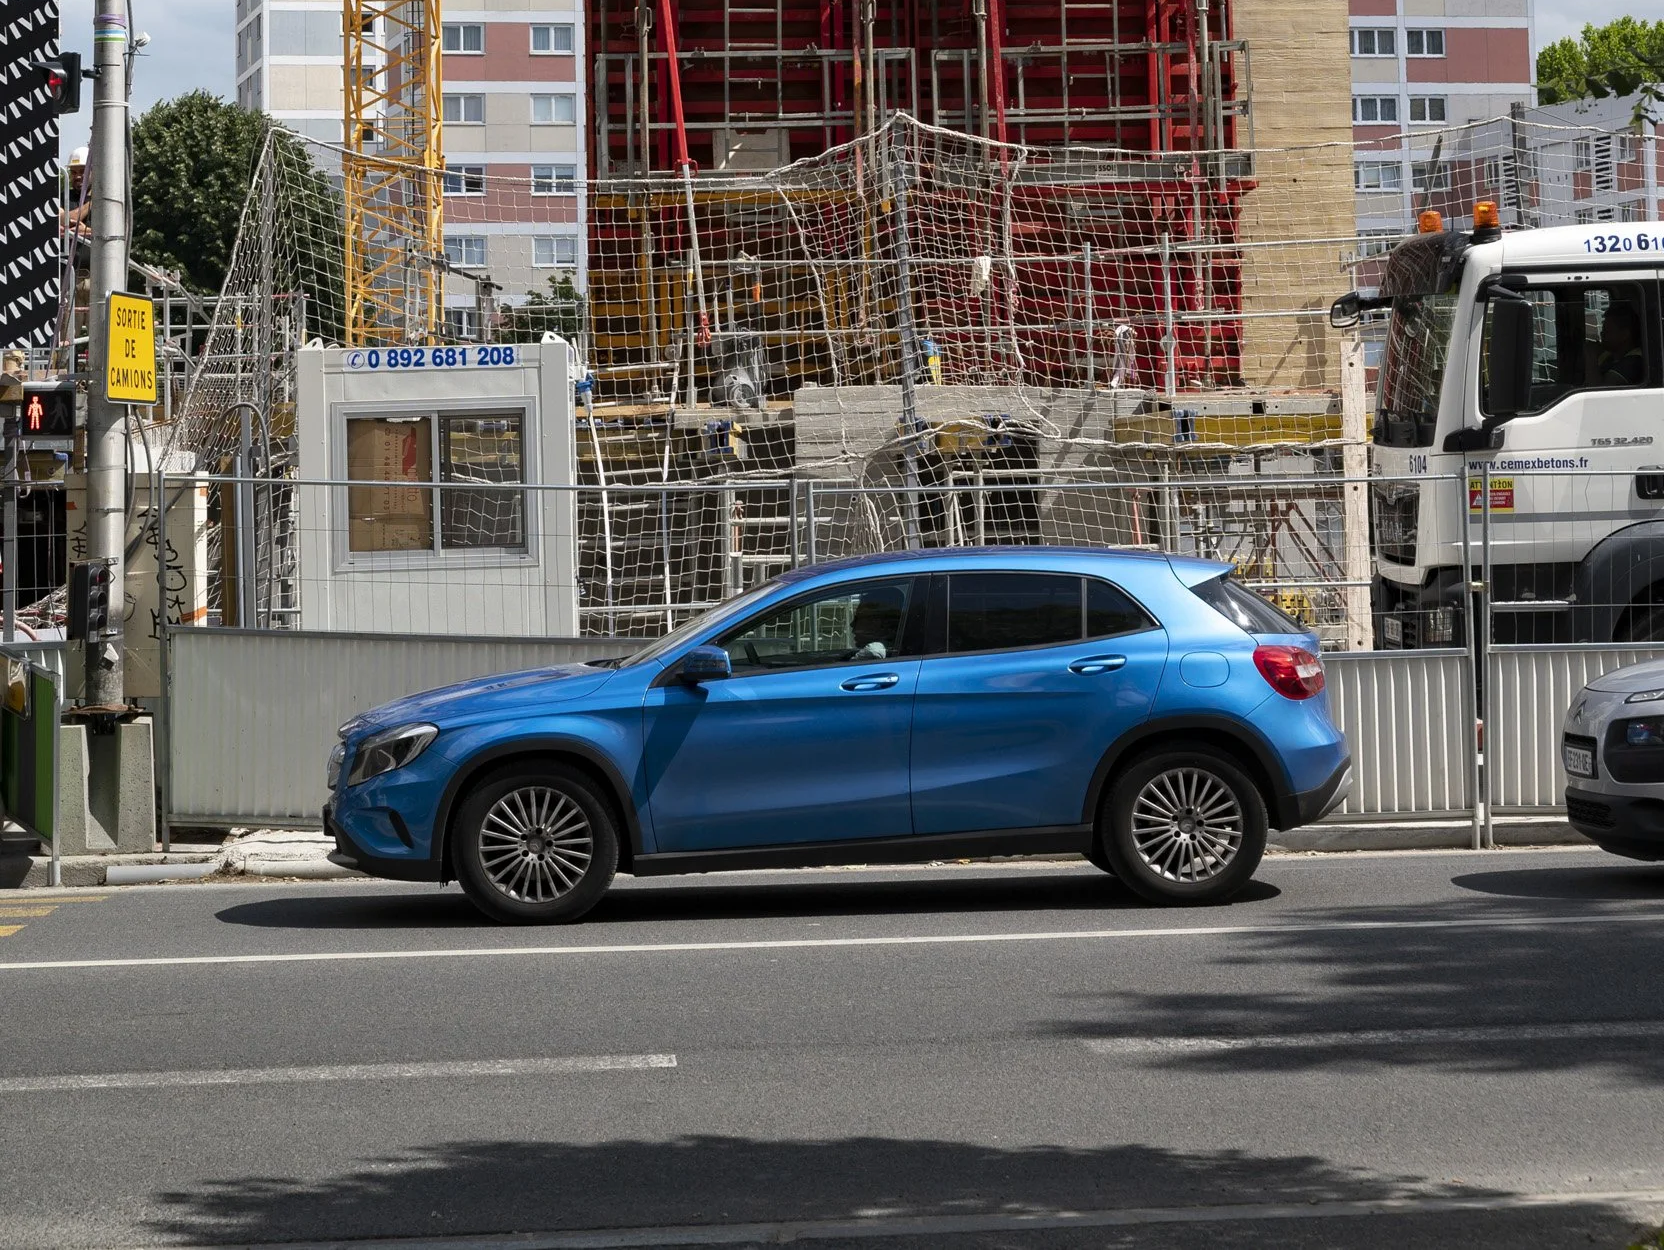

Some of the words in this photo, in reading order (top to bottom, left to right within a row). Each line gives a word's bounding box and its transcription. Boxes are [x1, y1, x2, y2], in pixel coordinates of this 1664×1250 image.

[1636, 232, 1664, 251] 61
[116, 307, 146, 330] SORTIE
[125, 338, 136, 359] DE
[368, 350, 380, 369] 0
[387, 349, 426, 368] 892
[431, 348, 467, 367] 681
[477, 346, 515, 366] 208
[110, 366, 153, 390] CAMIONS
[1613, 436, 1654, 446] 32.420
[1409, 454, 1427, 474] 6104
[1470, 480, 1513, 489] ATTNTION
